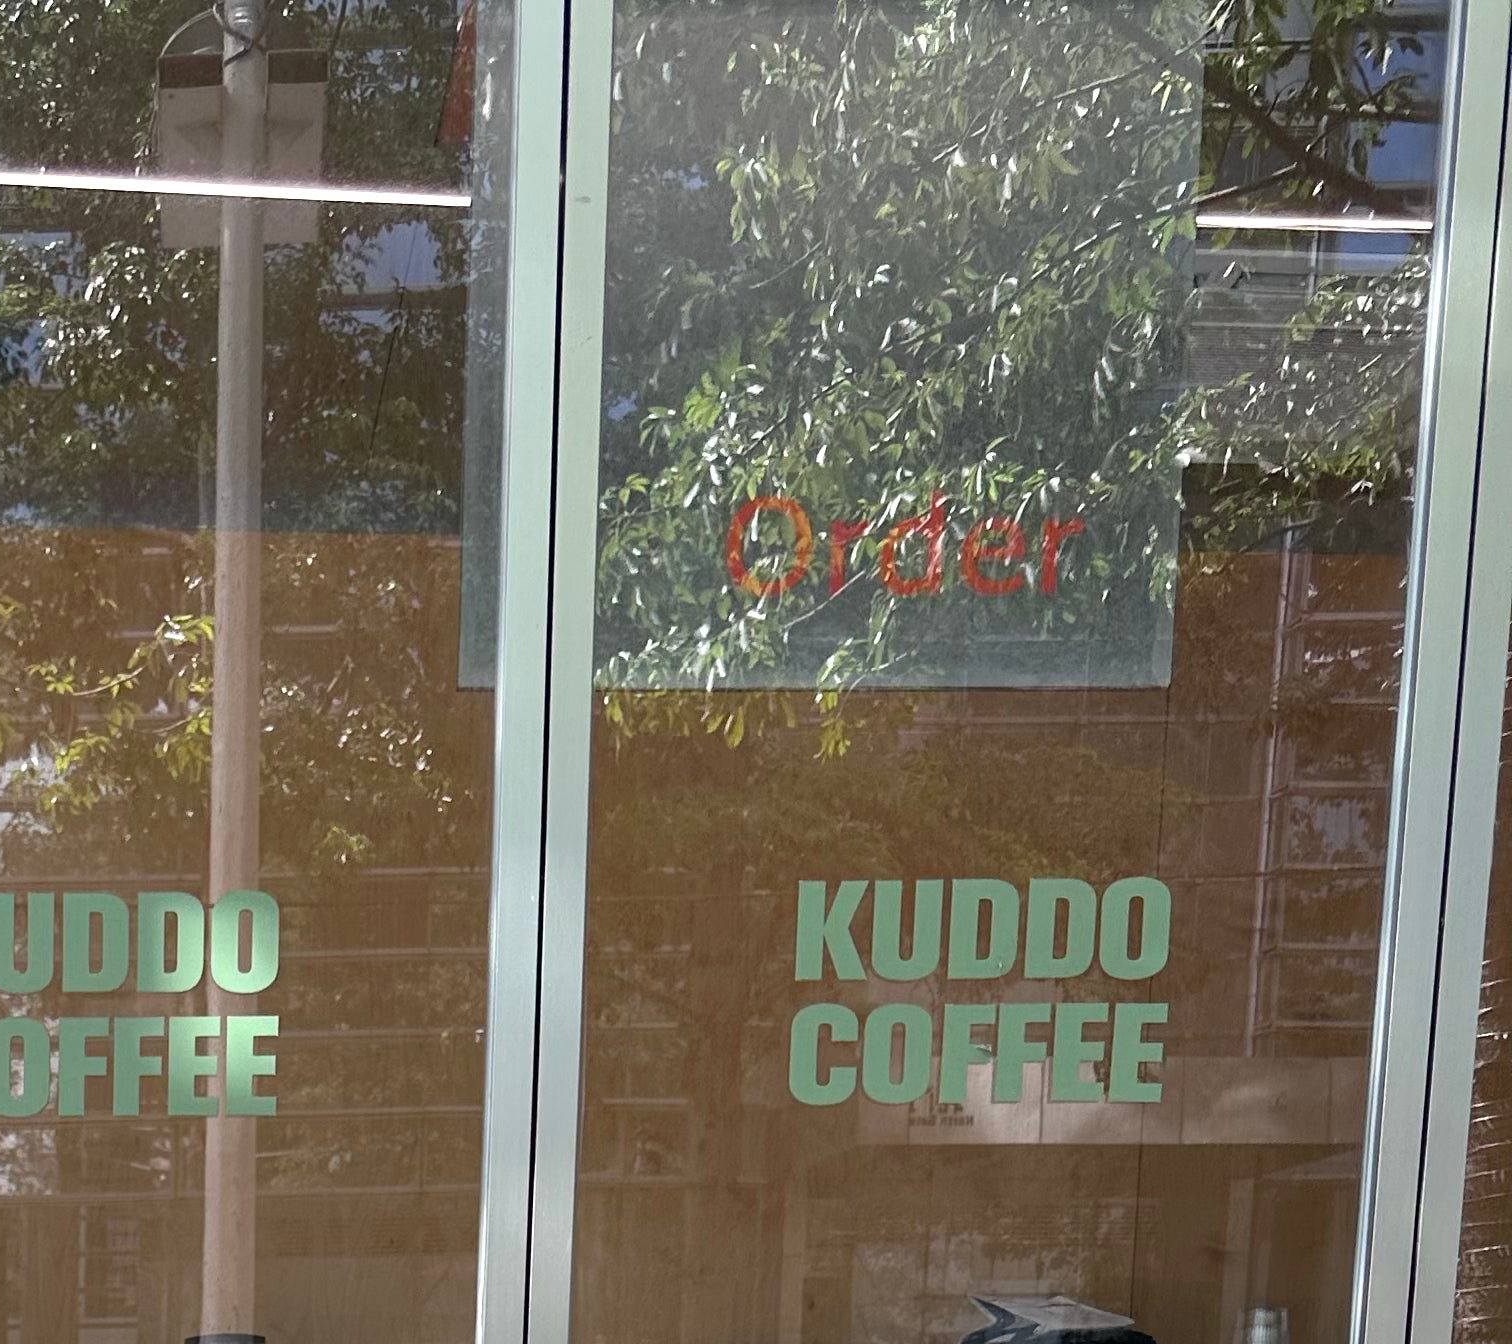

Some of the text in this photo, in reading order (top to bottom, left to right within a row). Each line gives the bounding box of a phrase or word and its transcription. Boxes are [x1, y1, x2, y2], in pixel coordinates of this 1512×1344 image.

[727, 491, 1085, 596] Order
[794, 876, 1172, 981] KUDDO
[788, 1003, 1170, 1106] COFFEE
